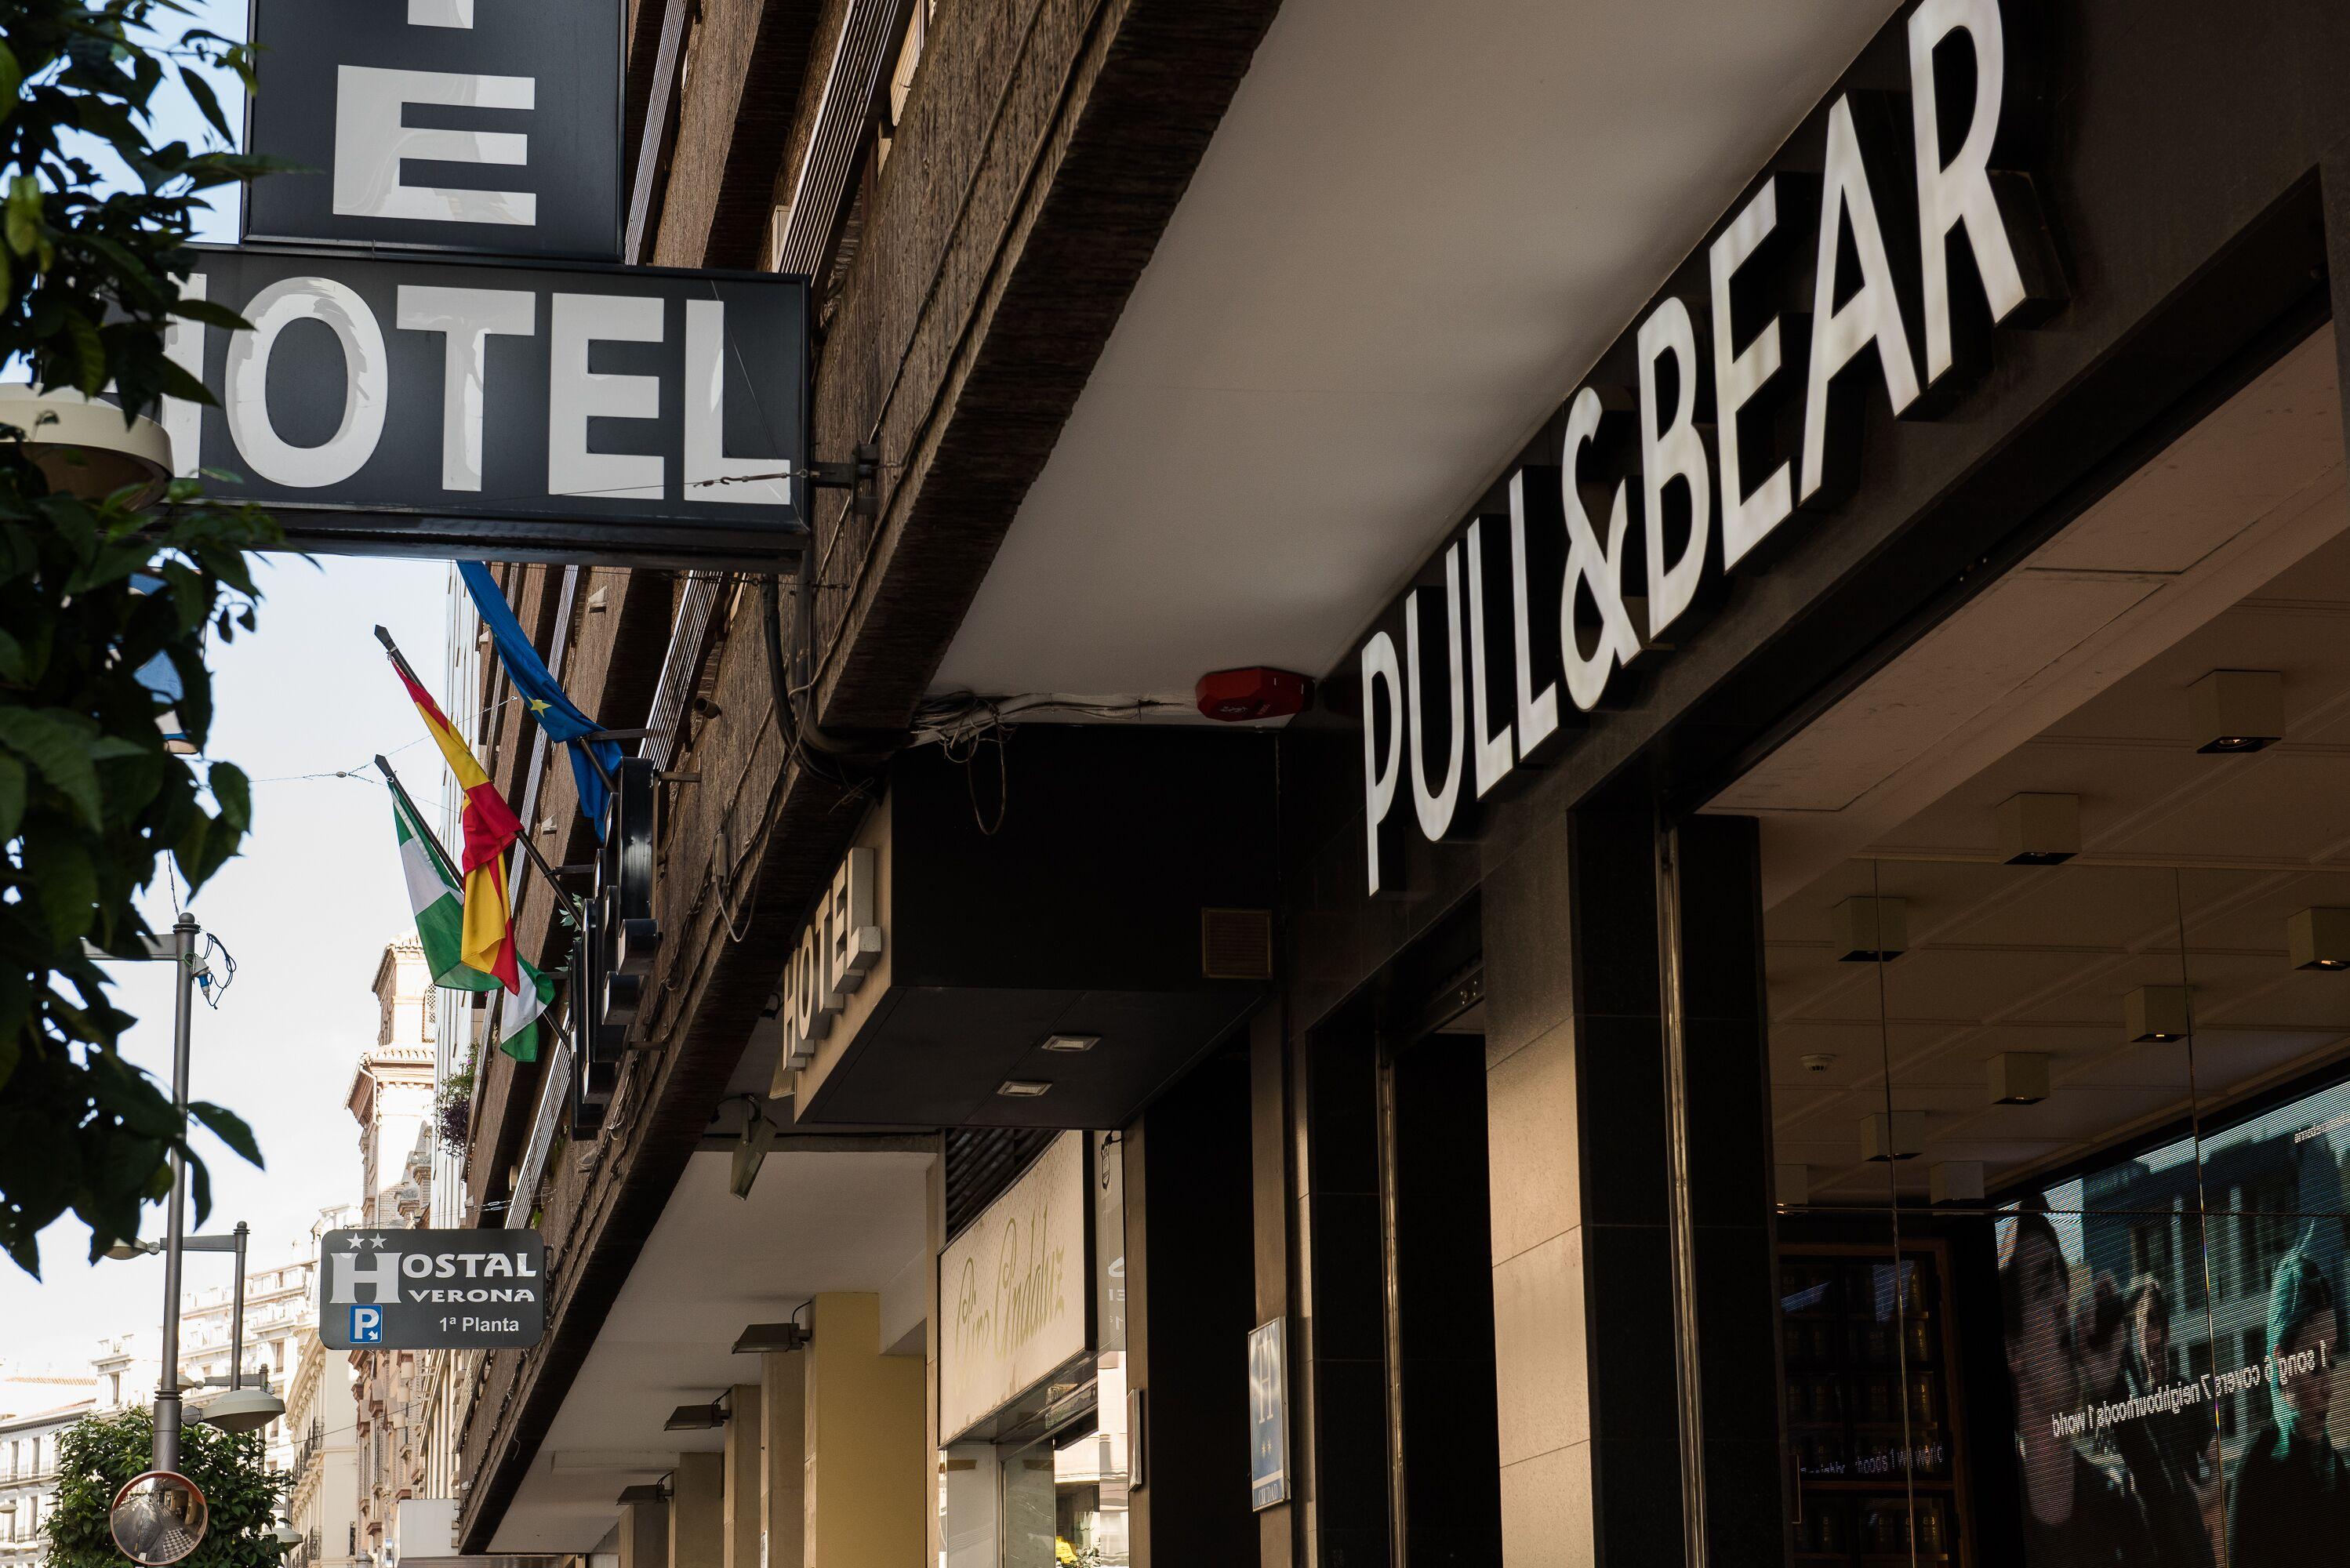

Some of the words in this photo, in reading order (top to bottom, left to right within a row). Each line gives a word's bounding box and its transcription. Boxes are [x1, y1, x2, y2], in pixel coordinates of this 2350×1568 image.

[333, 0, 536, 226] E
[1362, 0, 2026, 898] PULL&BEAR
[783, 847, 881, 1073] HOTEL
[329, 1252, 536, 1304] HOSTAL
[408, 1289, 536, 1303] VERONA
[439, 1316, 456, 1332] 1ª
[462, 1316, 520, 1332] Planta
